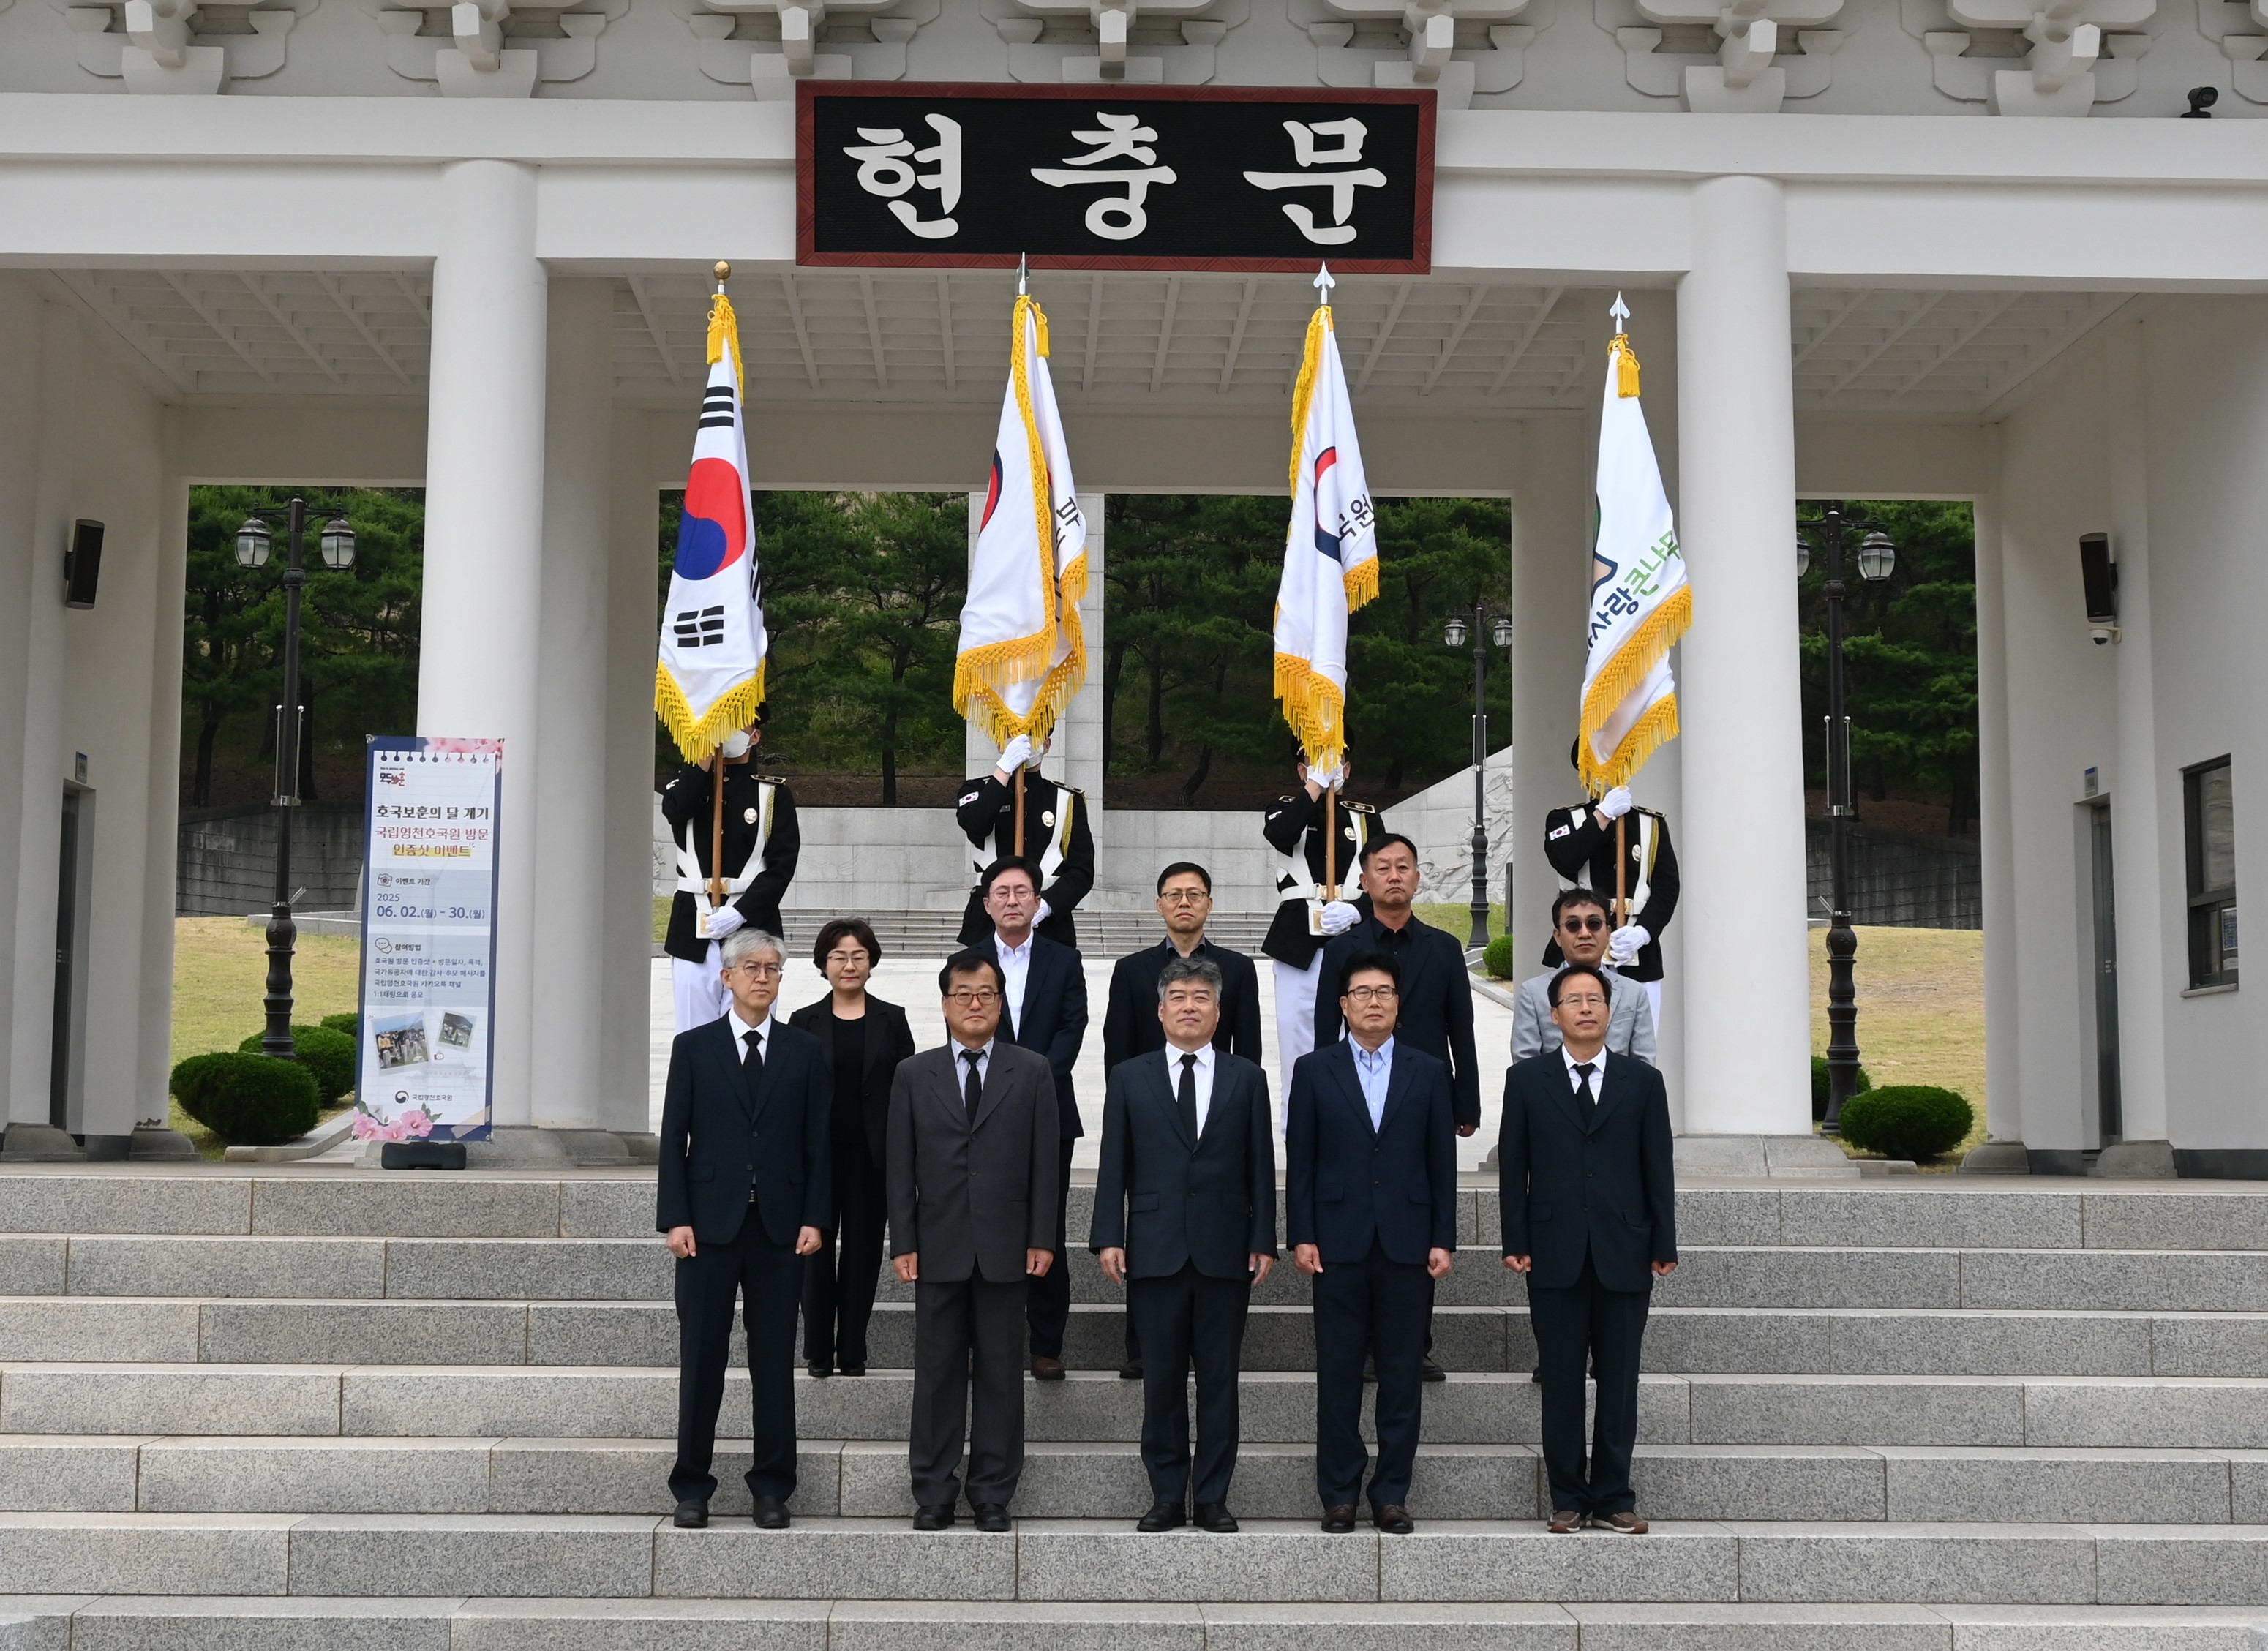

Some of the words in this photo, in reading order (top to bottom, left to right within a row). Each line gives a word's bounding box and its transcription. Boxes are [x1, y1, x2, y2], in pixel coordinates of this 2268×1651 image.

[842, 111, 1388, 246] 현충문
[376, 805, 441, 819] 호국보훈의
[447, 807, 459, 819] 달
[464, 807, 489, 820] 계기
[375, 826, 460, 840] 국립영천호국원
[465, 828, 489, 840] 방문
[434, 845, 470, 857] 이벤트
[418, 878, 430, 886] 기간
[377, 893, 400, 902] 2025
[376, 906, 397, 918] 06.
[400, 906, 437, 919] 02.(월)
[448, 907, 485, 919] 30.(월)
[375, 968, 413, 976] 국가유공자에
[374, 979, 418, 988] 국립영천호국원
